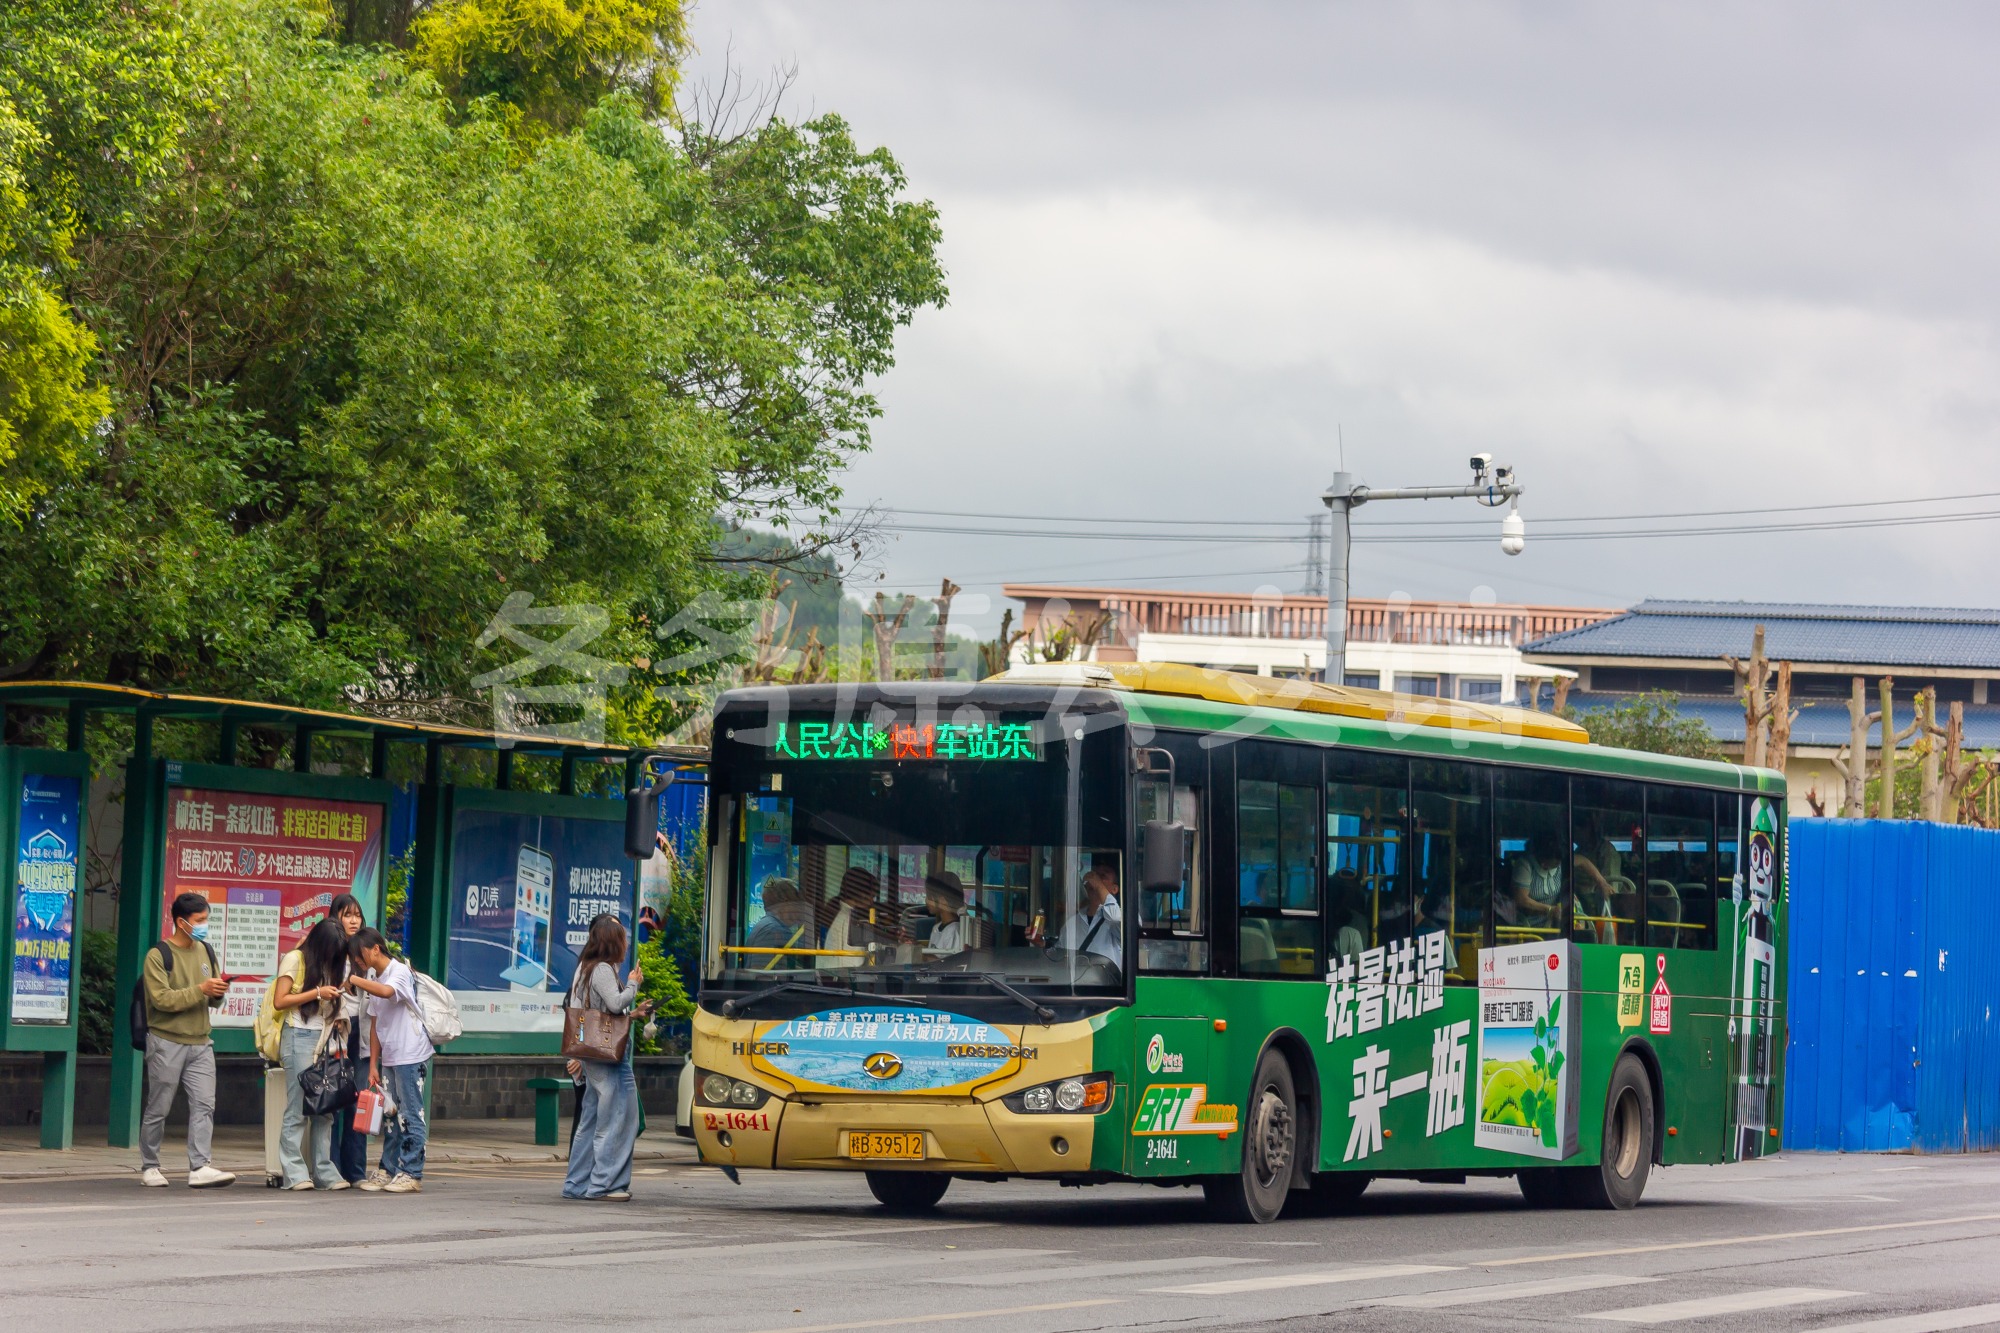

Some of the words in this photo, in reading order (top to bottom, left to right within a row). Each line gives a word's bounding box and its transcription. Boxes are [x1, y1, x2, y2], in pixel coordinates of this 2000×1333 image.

[570, 867, 621, 896] 柳州找好房
[481, 886, 499, 908] 贝壳
[1548, 957, 1559, 968] OTC
[1325, 929, 1445, 1044] 祛暑祛湿
[1623, 966, 1640, 988] 不含
[1483, 1000, 1534, 1023] 藿香正气口服液
[1621, 994, 1641, 1016] 酒精
[781, 1021, 879, 1039] 人民城市人民建
[887, 1024, 989, 1043] 人民城市为人民
[732, 1041, 790, 1056] HIGER
[947, 1044, 1038, 1060] KLQ6129GQ1
[1343, 1019, 1471, 1163] 来一瓶
[1134, 1087, 1193, 1131] BRT
[705, 1112, 771, 1131] 2-1641
[1147, 1139, 1177, 1158] 2-1641
